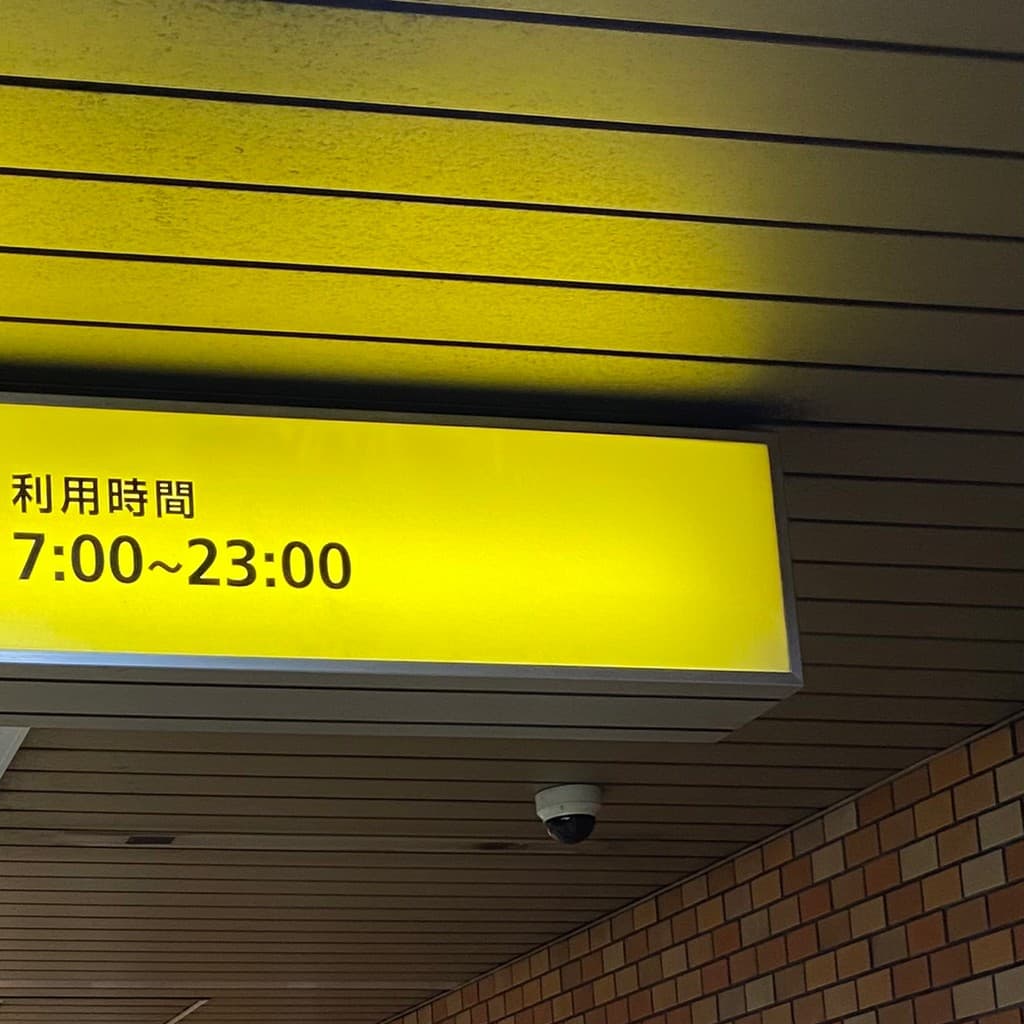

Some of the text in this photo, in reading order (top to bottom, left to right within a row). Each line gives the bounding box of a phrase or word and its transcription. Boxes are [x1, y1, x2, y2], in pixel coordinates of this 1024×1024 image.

[12, 473, 194, 519] 利用時間
[13, 532, 351, 590] 7:00~23:00
